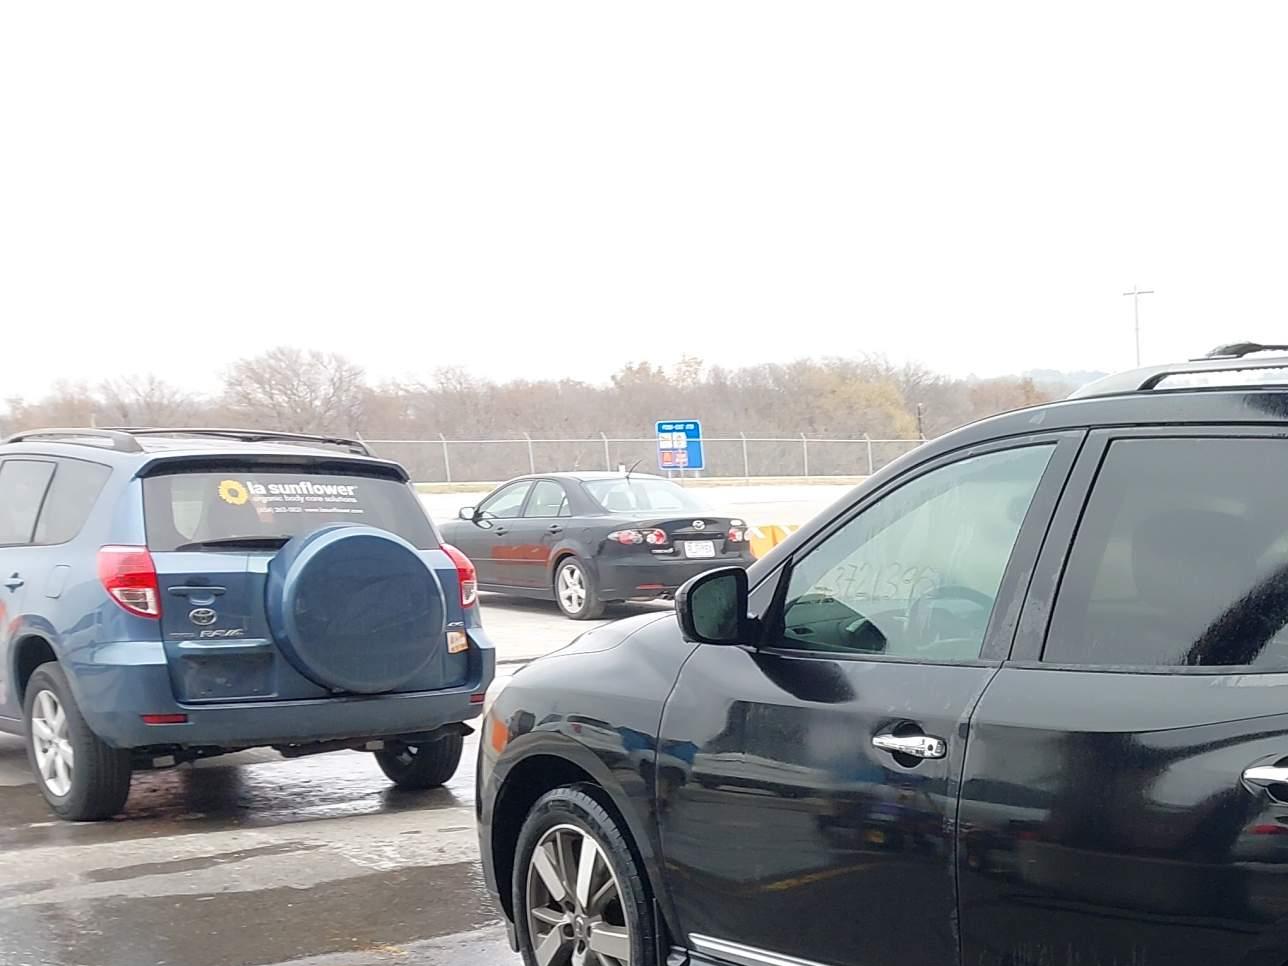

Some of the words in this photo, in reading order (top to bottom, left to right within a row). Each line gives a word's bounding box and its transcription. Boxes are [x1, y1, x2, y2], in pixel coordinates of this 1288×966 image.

[246, 481, 267, 495] la
[268, 481, 354, 496] sunflower
[284, 495, 305, 503] body
